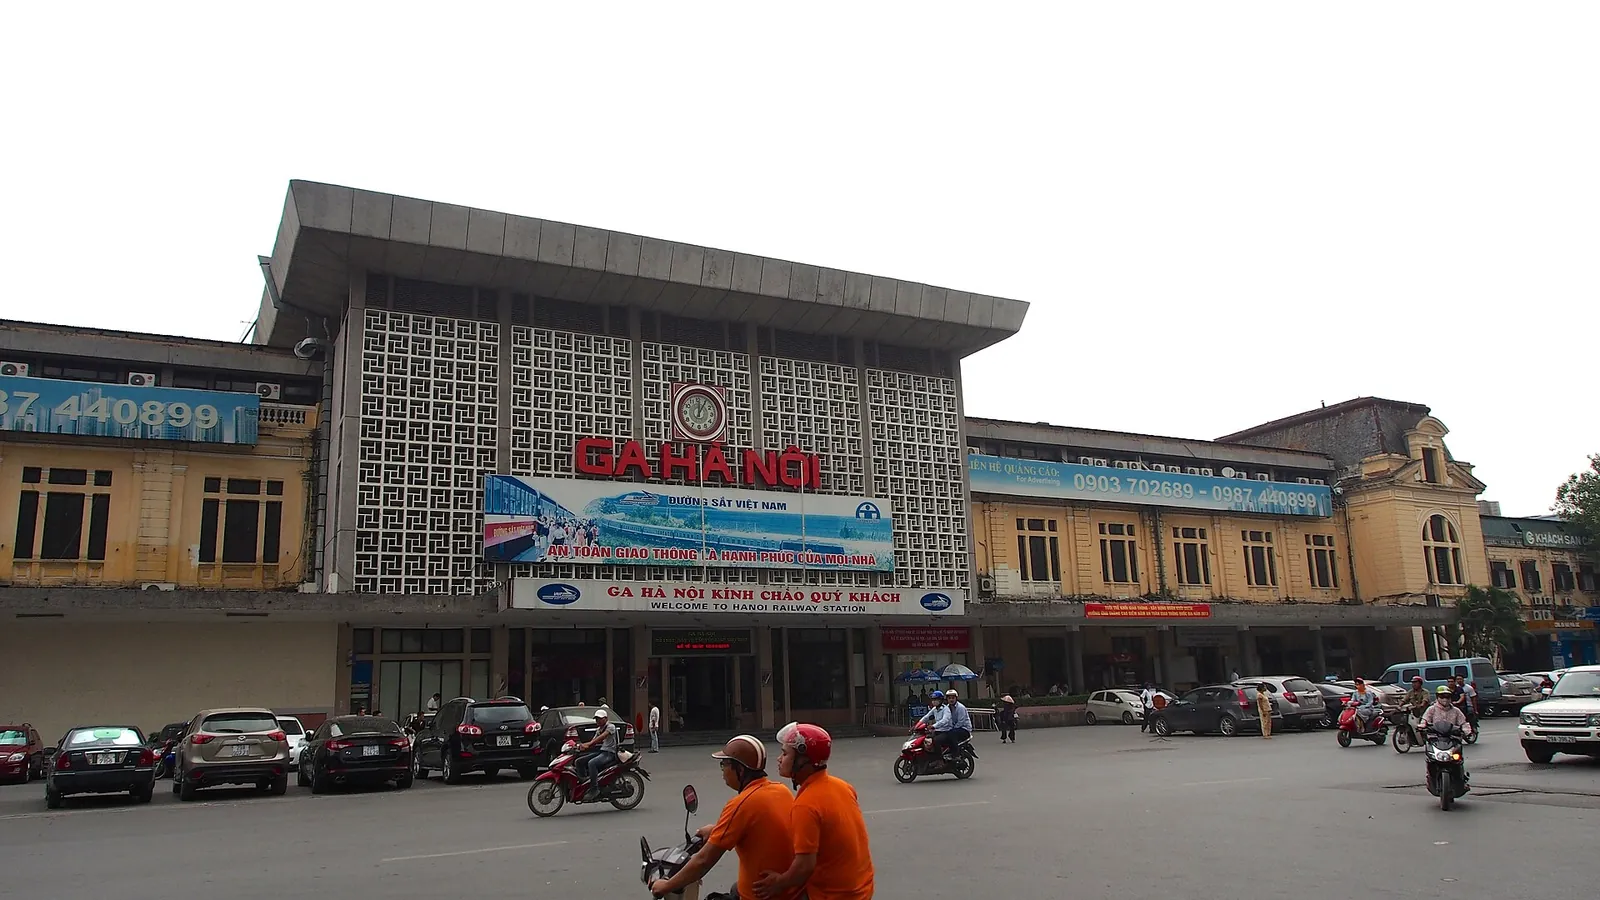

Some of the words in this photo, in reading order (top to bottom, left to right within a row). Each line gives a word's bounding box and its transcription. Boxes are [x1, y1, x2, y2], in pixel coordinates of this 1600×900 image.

[54, 395, 219, 429] 440899
[576, 437, 651, 478] GA
[660, 442, 736, 483] HÀ
[743, 445, 821, 489] NỘI
[968, 459, 987, 471] IÊN
[989, 461, 1001, 473] HỆ
[1004, 463, 1036, 475] QUẢNG
[1038, 465, 1060, 477] CÁO:
[1028, 476, 1060, 487] Advertising
[1073, 473, 1121, 493] 0903
[1126, 478, 1194, 499] 702689
[1212, 486, 1252, 504] 0987
[1258, 487, 1317, 508] 440899
[736, 498, 758, 510] VIỆT
[762, 501, 787, 510] NAM
[547, 545, 569, 557] AN
[572, 545, 611, 558] TOÀN
[615, 547, 649, 559] GIAO
[652, 546, 698, 560] THÔNG
[721, 550, 757, 564] HẠNH
[761, 550, 794, 563] PHÚC
[825, 553, 849, 566] MỌI
[852, 552, 876, 566] NHÀ
[607, 586, 634, 597] GA
[641, 585, 666, 598] HÀ
[673, 586, 705, 601] NỘI
[711, 587, 754, 600] KÍNH
[760, 587, 805, 600] CHÀO
[810, 589, 843, 603] QUÝ
[848, 590, 901, 603] KHÁCH
[651, 602, 708, 610] WELCOME
[772, 604, 818, 612] RAILWAY
